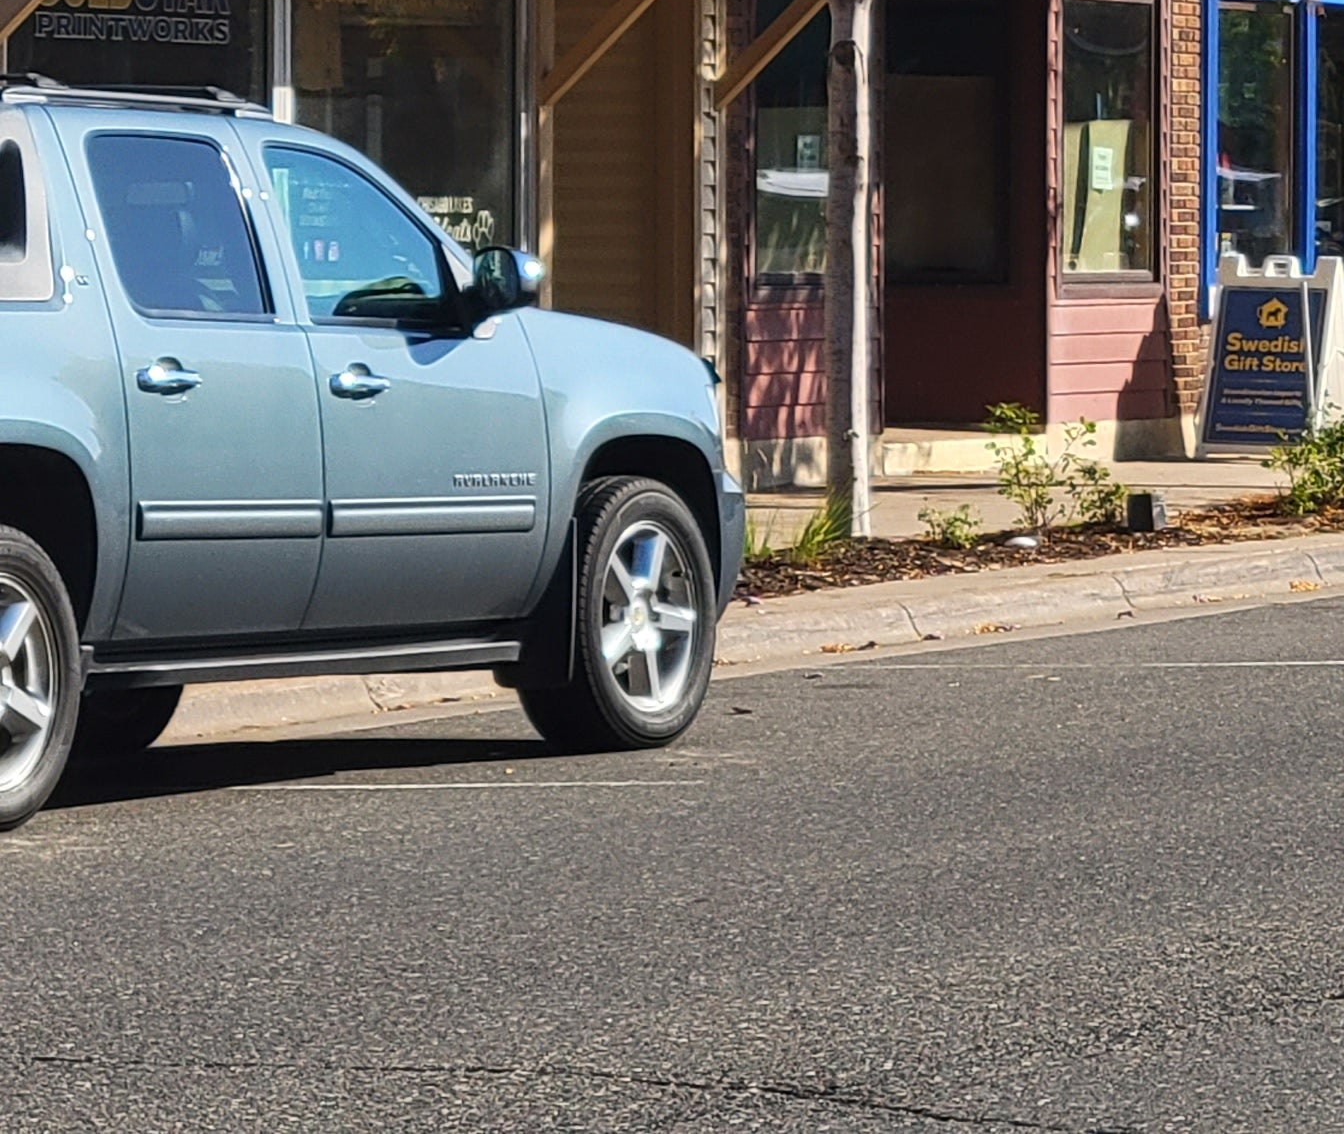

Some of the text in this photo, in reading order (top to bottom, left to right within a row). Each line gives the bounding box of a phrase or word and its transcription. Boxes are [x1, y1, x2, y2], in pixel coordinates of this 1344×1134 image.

[34, 10, 231, 45] PRINTWORKS
[1224, 354, 1259, 371] Gift
[453, 472, 537, 487] AVALANCHE
